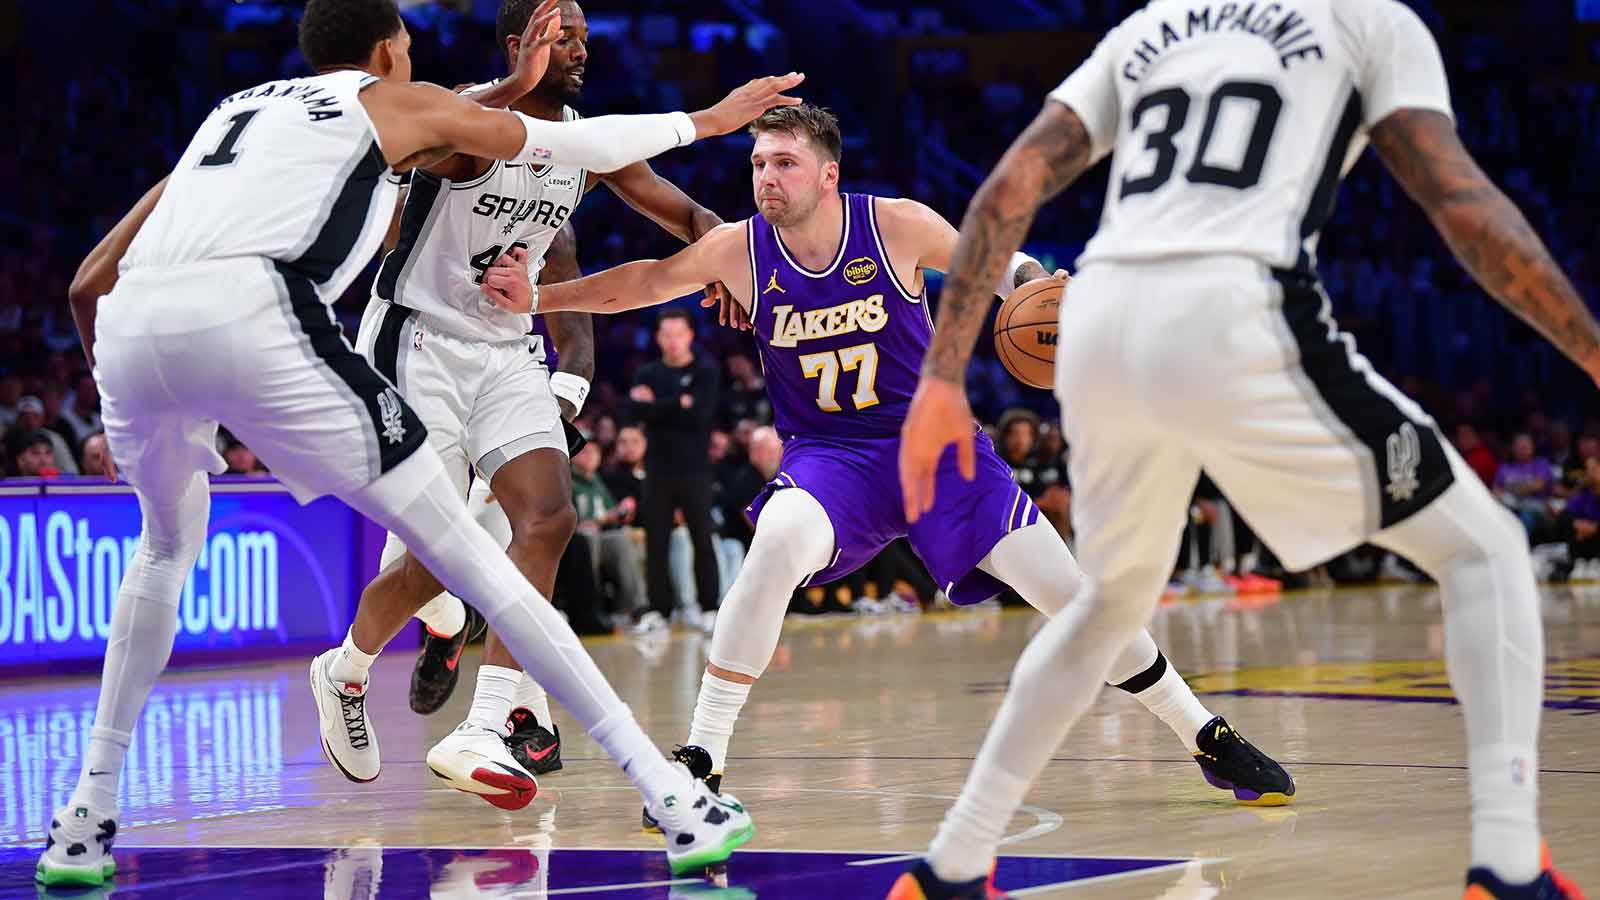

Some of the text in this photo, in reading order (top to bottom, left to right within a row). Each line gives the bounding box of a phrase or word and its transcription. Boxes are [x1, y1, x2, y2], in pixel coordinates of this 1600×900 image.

[1123, 3, 1323, 82] CHAMPAGNIE
[196, 107, 262, 167] 1
[1119, 81, 1283, 201] 30
[548, 178, 571, 186] LEDGER
[472, 193, 569, 235] SPURS
[846, 263, 875, 276] bibigo
[769, 294, 889, 348] LAKERS
[798, 342, 880, 412] 77
